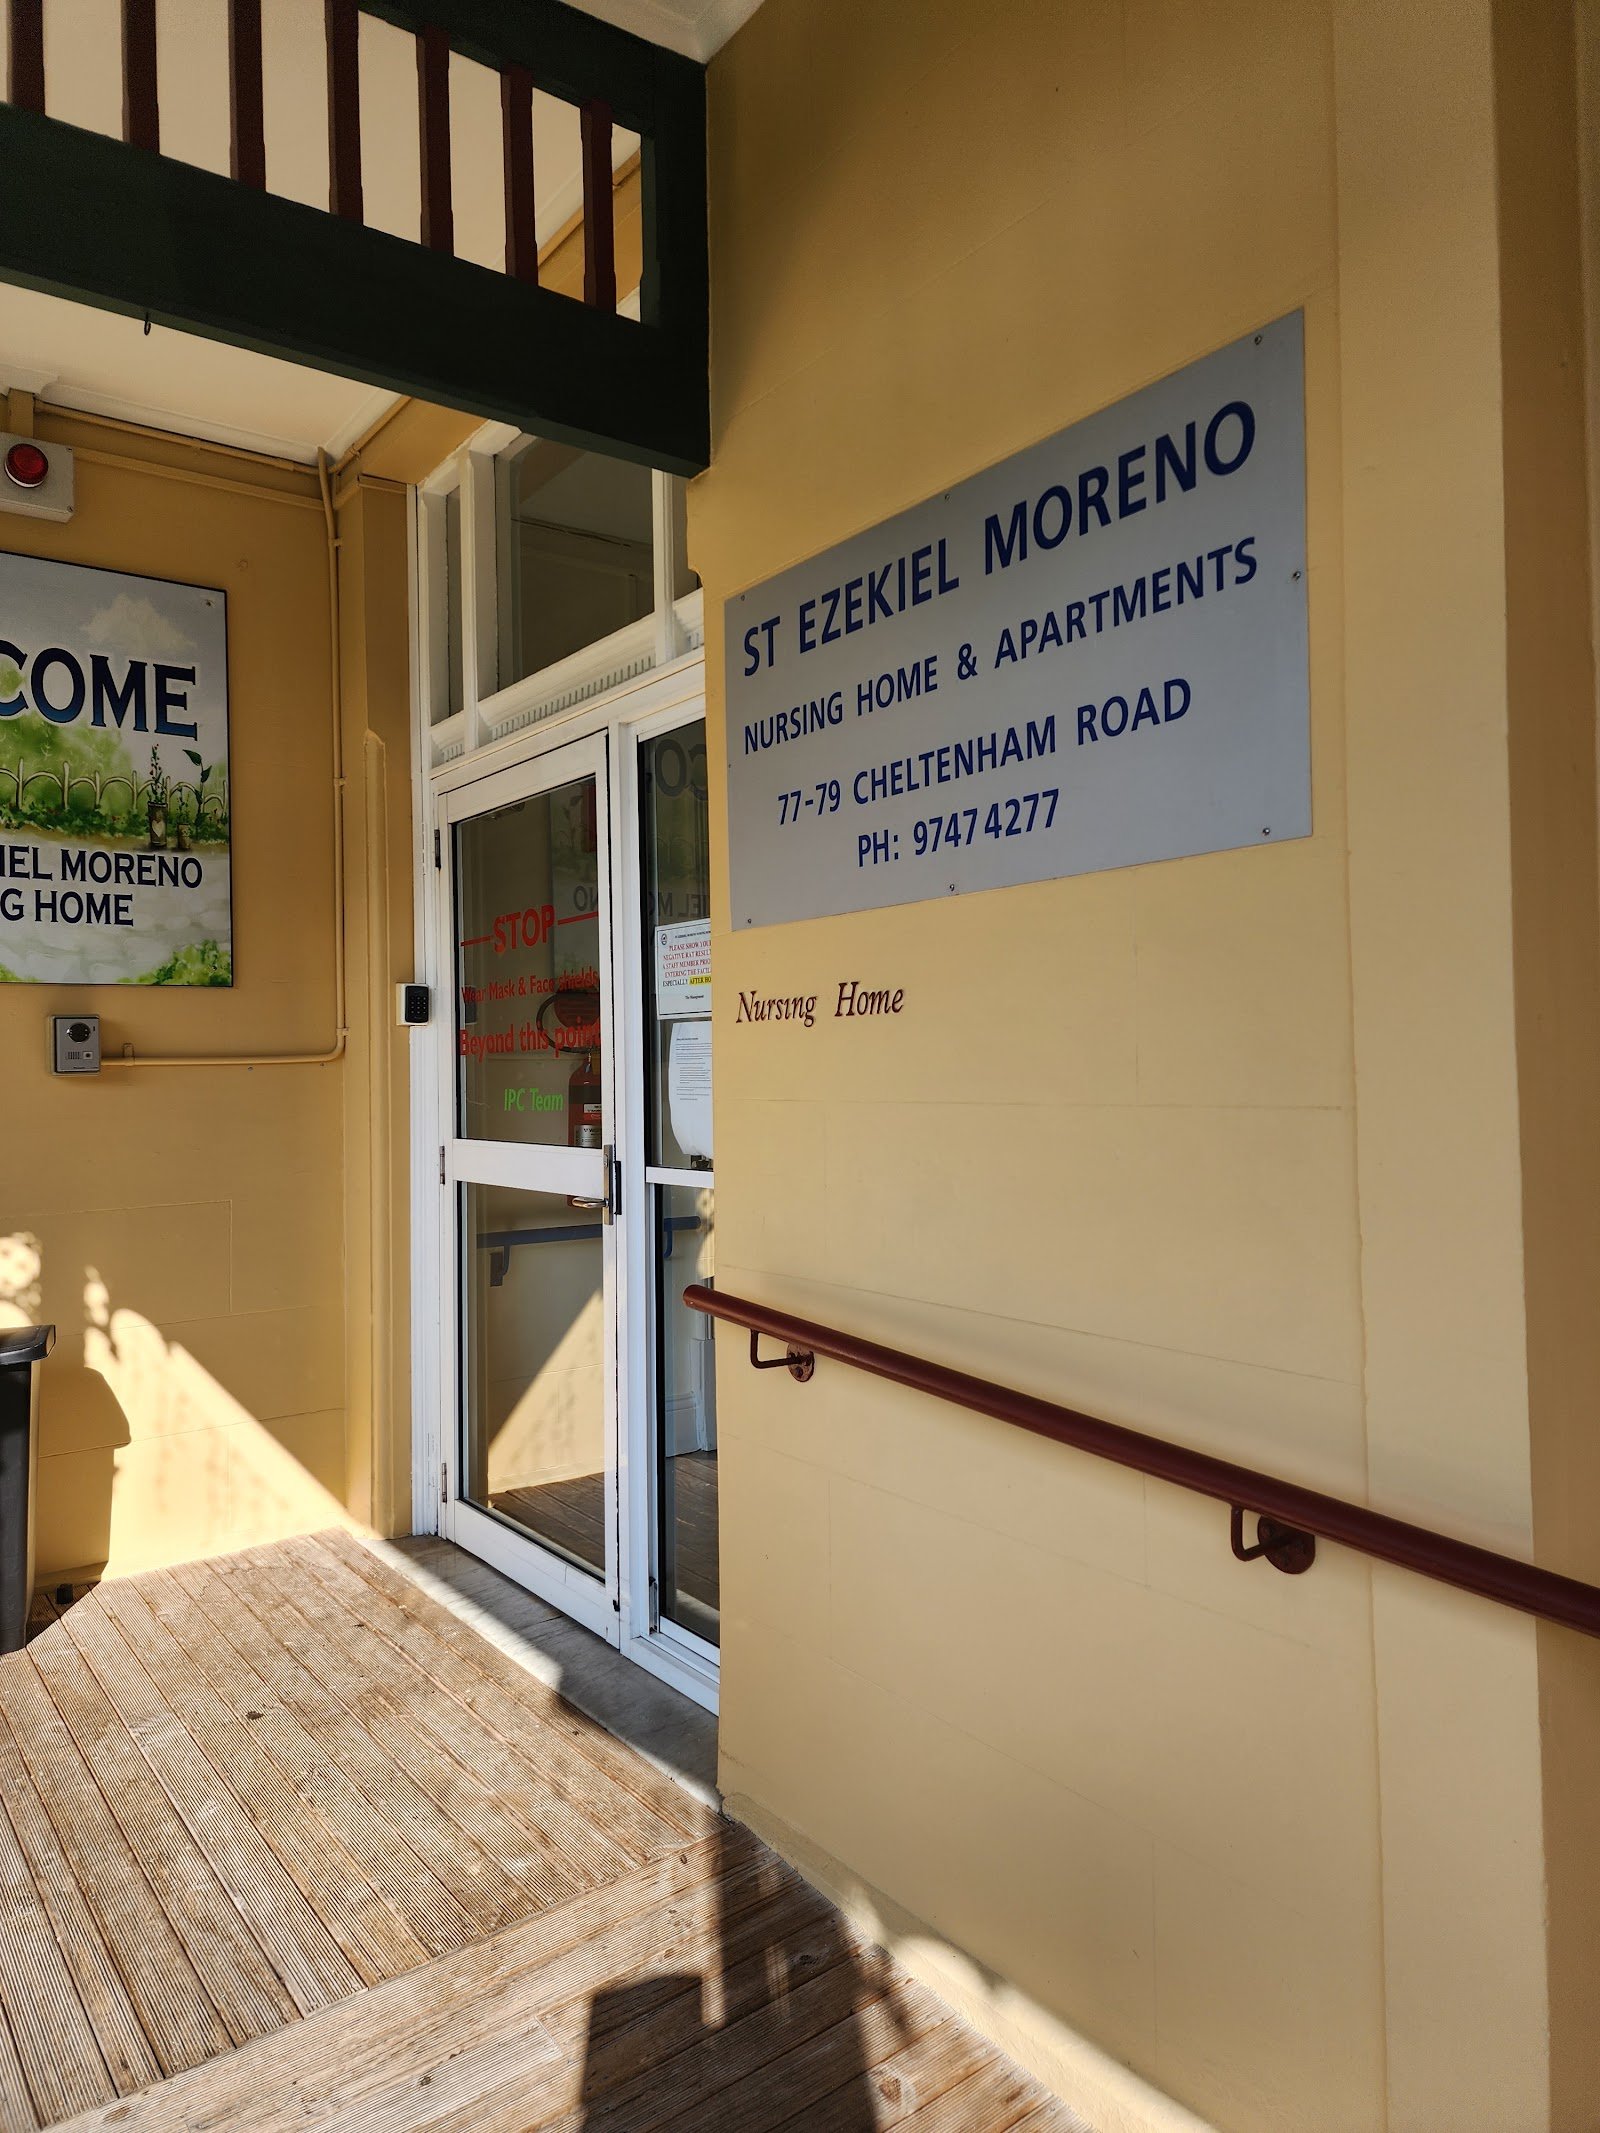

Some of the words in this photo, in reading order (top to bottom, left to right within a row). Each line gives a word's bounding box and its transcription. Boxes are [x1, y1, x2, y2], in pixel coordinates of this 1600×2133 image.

[744, 617, 780, 677] ST
[799, 540, 960, 653] EZEKIEL
[984, 401, 1256, 575] MORENO
[744, 691, 844, 755] NURSING
[857, 655, 939, 716] HOME
[957, 643, 978, 681] &
[994, 535, 1259, 668] APARTMENTS
[777, 779, 842, 823] 77-79
[853, 714, 1057, 805] CHELTENHAM
[1077, 677, 1192, 746] ROAD
[60, 848, 203, 889] MORENO
[858, 829, 901, 868] PH:
[34, 889, 134, 927] HOME
[493, 904, 556, 953] STOP
[462, 985, 486, 1004] Wear
[489, 978, 515, 1001] Mask
[518, 976, 527, 997] &
[530, 975, 555, 994] Face
[559, 966, 598, 990] shields
[834, 981, 905, 1018] Home
[460, 1024, 516, 1062] Beyond
[519, 1022, 549, 1051] this
[504, 1088, 526, 1112] IPC
[530, 1087, 564, 1111] Team
